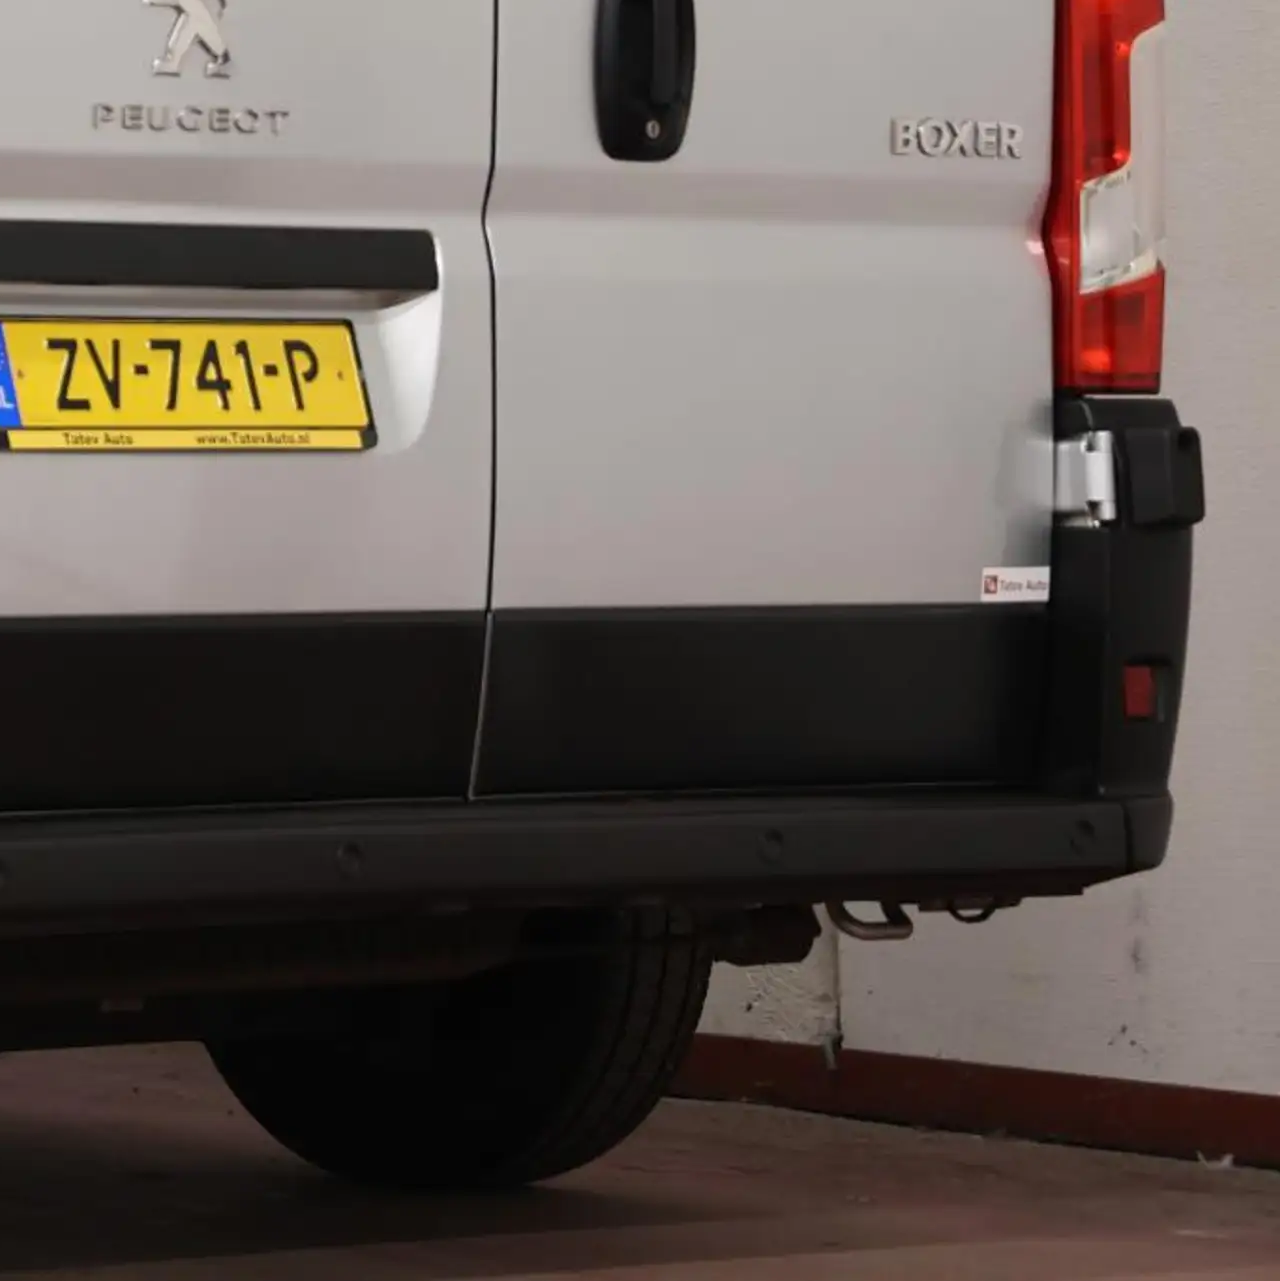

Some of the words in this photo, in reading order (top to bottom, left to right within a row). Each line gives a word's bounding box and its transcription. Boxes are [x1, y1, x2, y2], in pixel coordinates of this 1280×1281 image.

[92, 104, 290, 135] PEUGEOT
[890, 117, 1023, 159] BOXER
[45, 338, 320, 411] ZV-741-P
[103, 431, 134, 446] Auto
